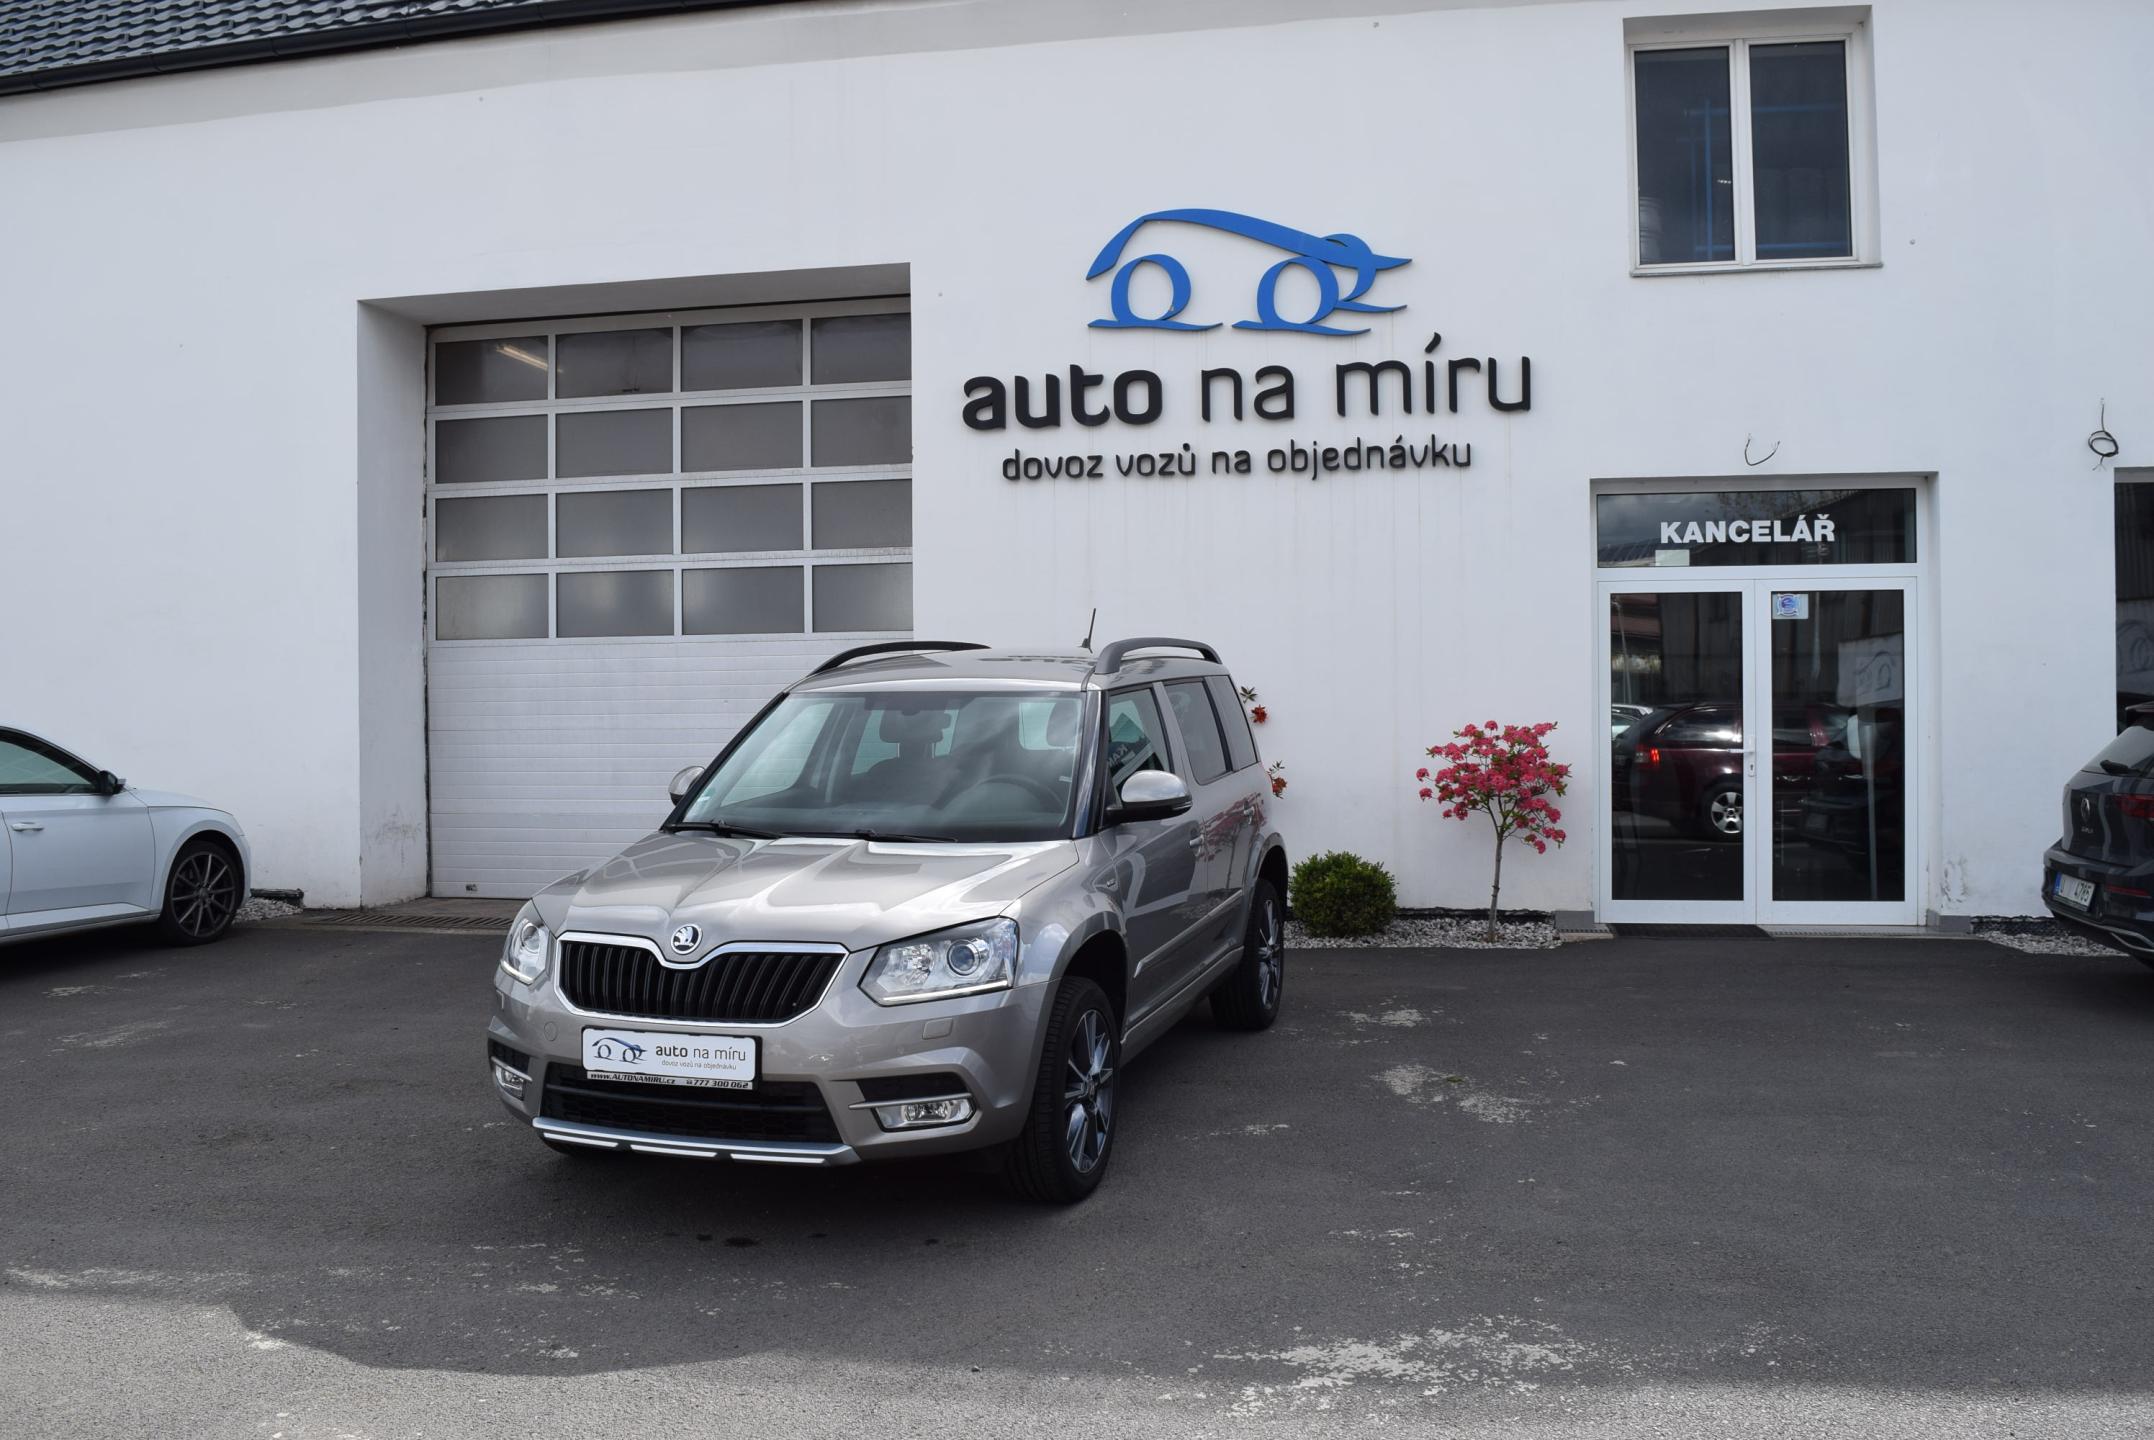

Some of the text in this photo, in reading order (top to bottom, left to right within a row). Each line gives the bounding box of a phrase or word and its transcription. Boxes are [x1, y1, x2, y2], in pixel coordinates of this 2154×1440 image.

[962, 332, 1532, 432] auto na míru
[1002, 433, 1472, 482] dovoz vozů na objednávku
[1660, 513, 1836, 544] KANCELÁŘ
[655, 1044, 746, 1061] auto na míru
[661, 1060, 679, 1068] dovoz
[694, 1079, 710, 1087] 777
[712, 1080, 729, 1088] 300
[730, 1081, 749, 1089] 062
